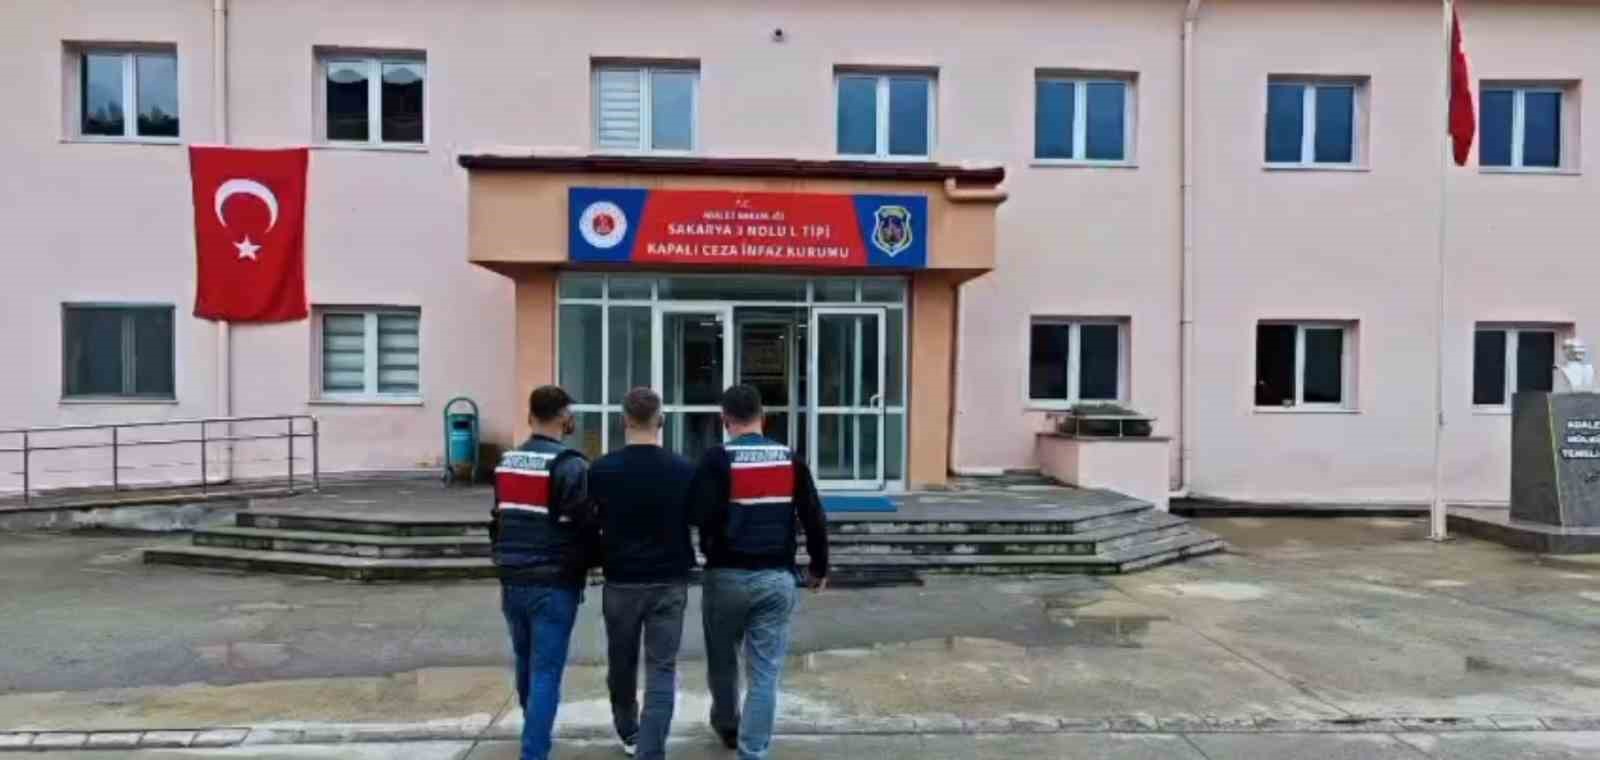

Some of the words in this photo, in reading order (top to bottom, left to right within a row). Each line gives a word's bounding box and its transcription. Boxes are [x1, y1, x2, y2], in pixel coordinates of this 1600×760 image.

[668, 223, 732, 235] SAKARYA
[803, 224, 831, 239] TİPİ
[647, 243, 698, 255] KAPALI
[702, 245, 738, 256] CEZA
[741, 243, 783, 257] İNFAZ
[787, 246, 849, 258] KURUMU
